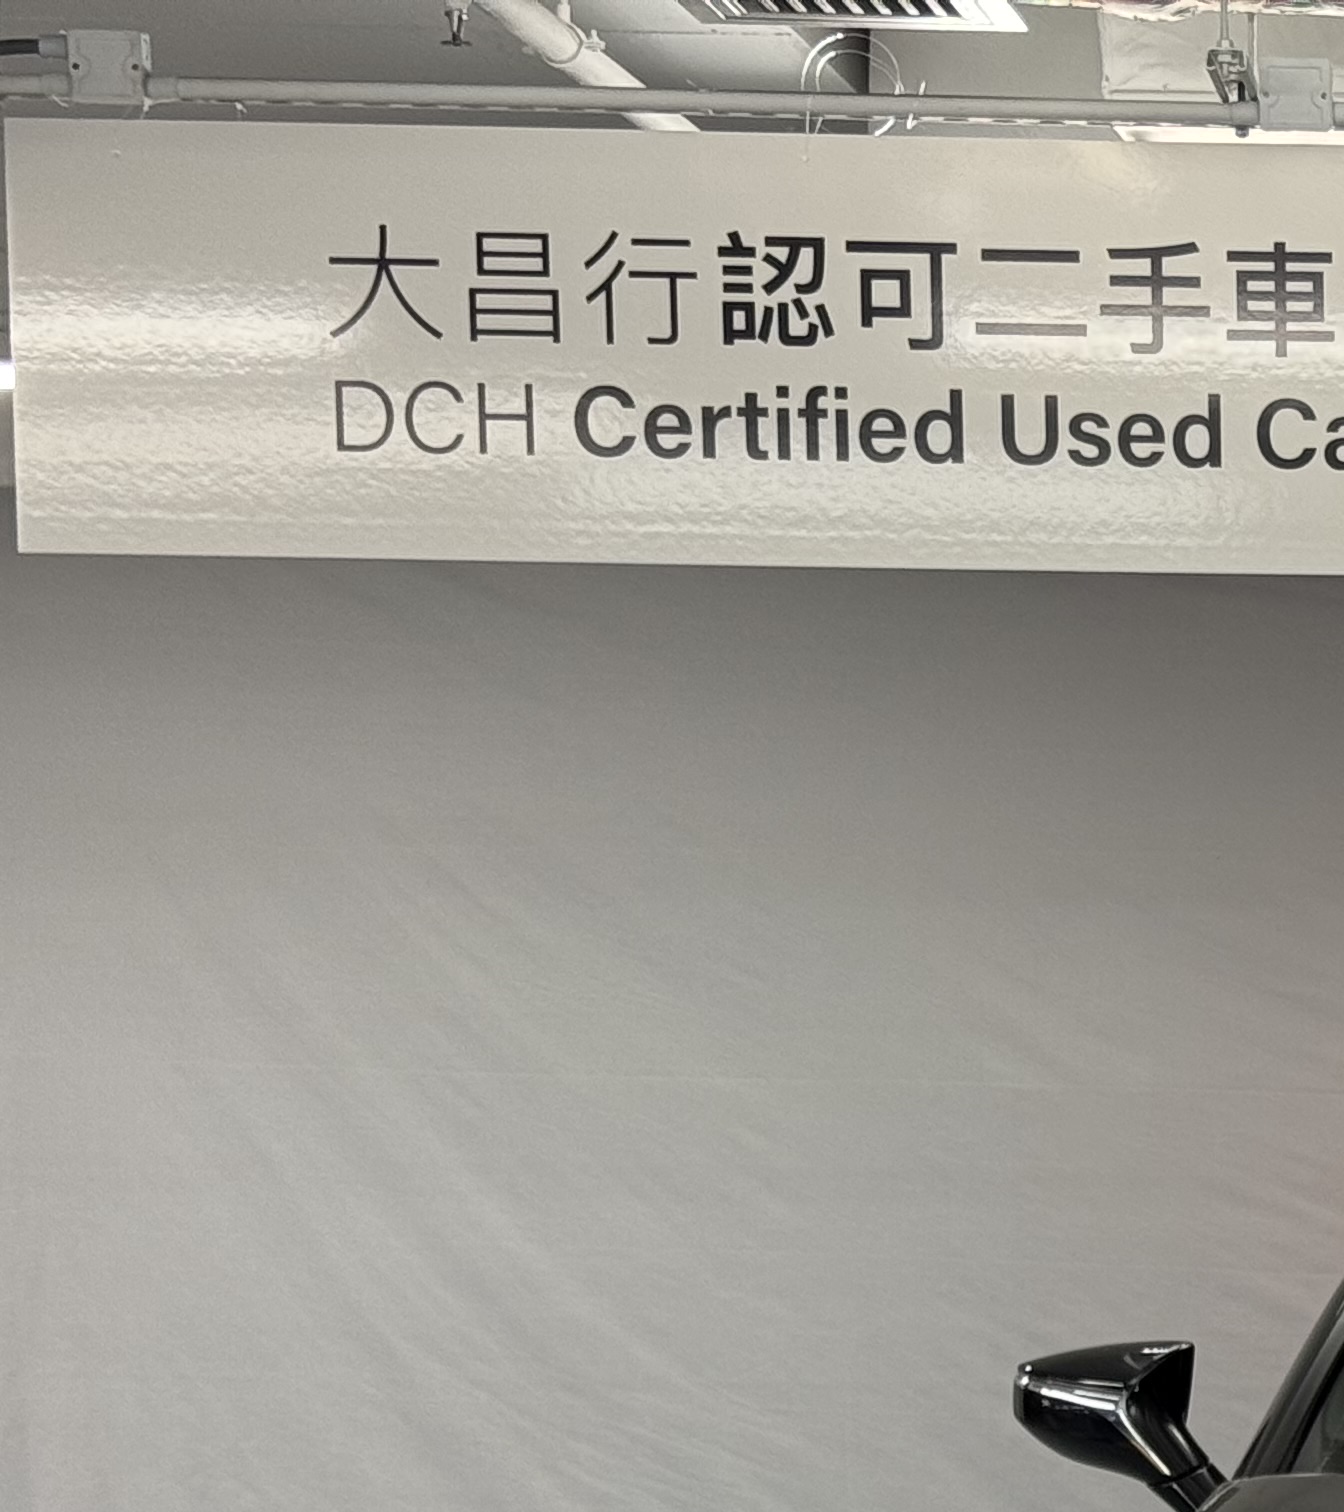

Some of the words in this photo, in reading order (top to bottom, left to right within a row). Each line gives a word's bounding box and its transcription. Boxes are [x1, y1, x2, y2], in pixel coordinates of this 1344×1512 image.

[328, 224, 1336, 358] 大昌行認可二手車
[335, 380, 537, 457] DCH
[574, 385, 966, 466] Certified
[1001, 390, 1223, 471] Used
